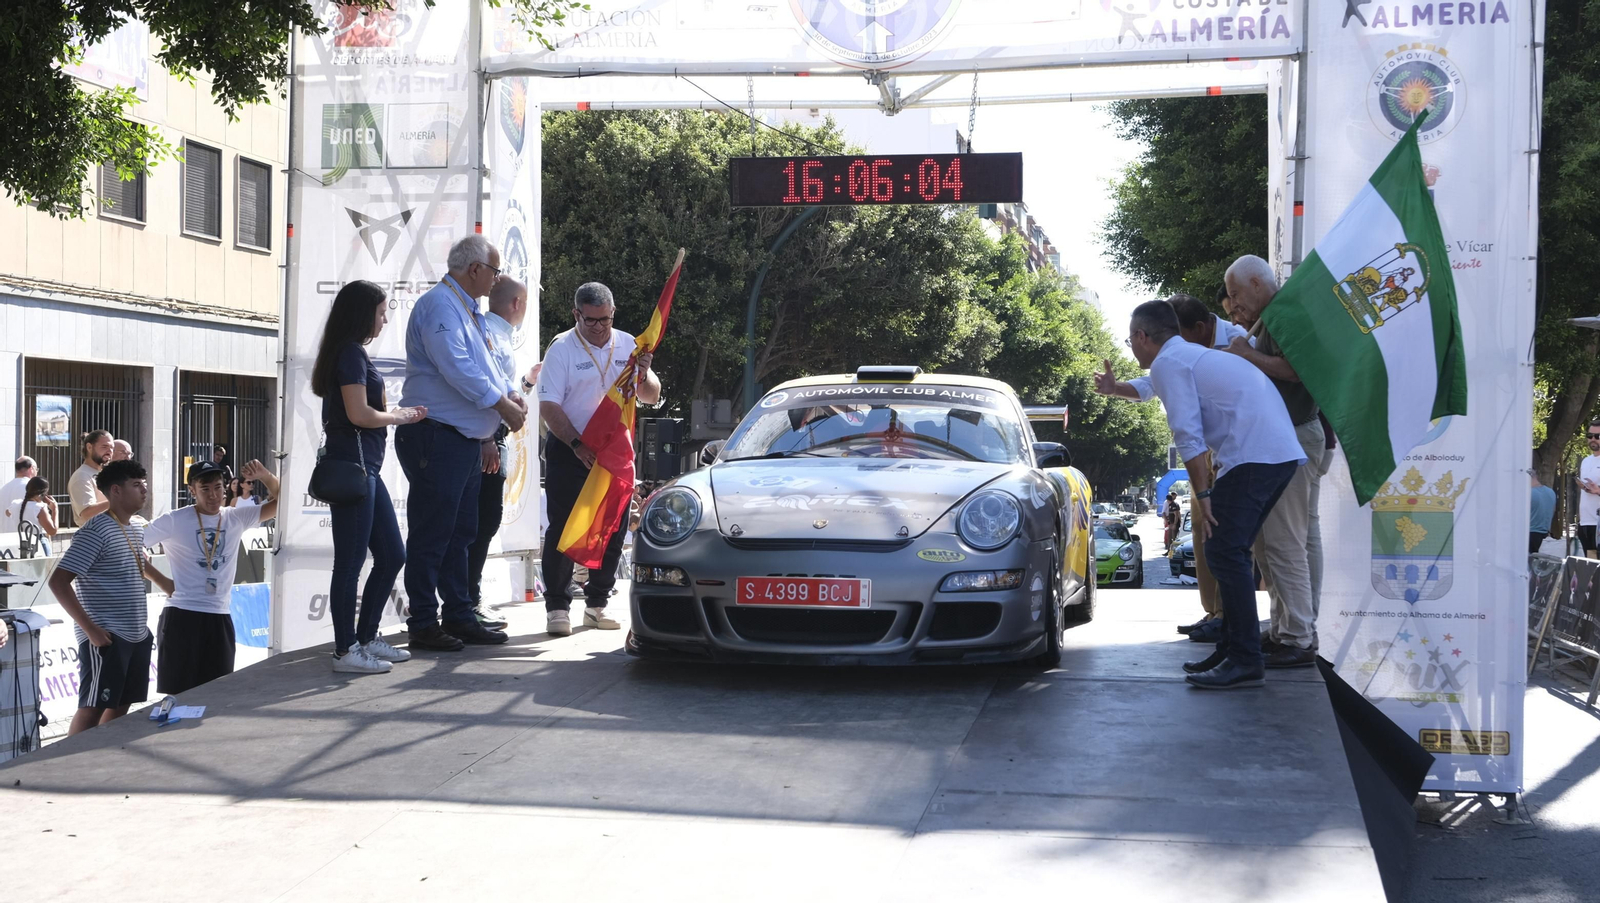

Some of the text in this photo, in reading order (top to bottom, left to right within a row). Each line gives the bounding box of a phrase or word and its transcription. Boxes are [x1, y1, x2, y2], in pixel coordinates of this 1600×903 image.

[546, 5, 661, 27] PUTACIÓN
[1149, 7, 1290, 43] ALMERÍA
[571, 28, 658, 49] ALMERÍA
[831, 45, 873, 60] septiembre
[920, 29, 938, 45] 2023
[1373, 51, 1460, 87] AUTOMOVIL CLUB
[399, 130, 437, 141] ALMERÍA
[782, 158, 964, 203] 16:06:04
[1456, 240, 1494, 253] Vícar
[1451, 257, 1483, 270] iente
[792, 386, 998, 404] AUTOMÓVIL CLUB ALMER
[1412, 453, 1423, 461] de
[1424, 453, 1465, 463] Alboloduy
[764, 582, 809, 600] 4399
[818, 583, 853, 602] BCJ
[1339, 609, 1396, 620] Ayuntamiento
[1397, 610, 1408, 618] de
[1408, 610, 1441, 619] Alhama
[1442, 611, 1453, 619] de
[1436, 693, 1450, 702] DE
[1422, 732, 1507, 746] DRAGO
